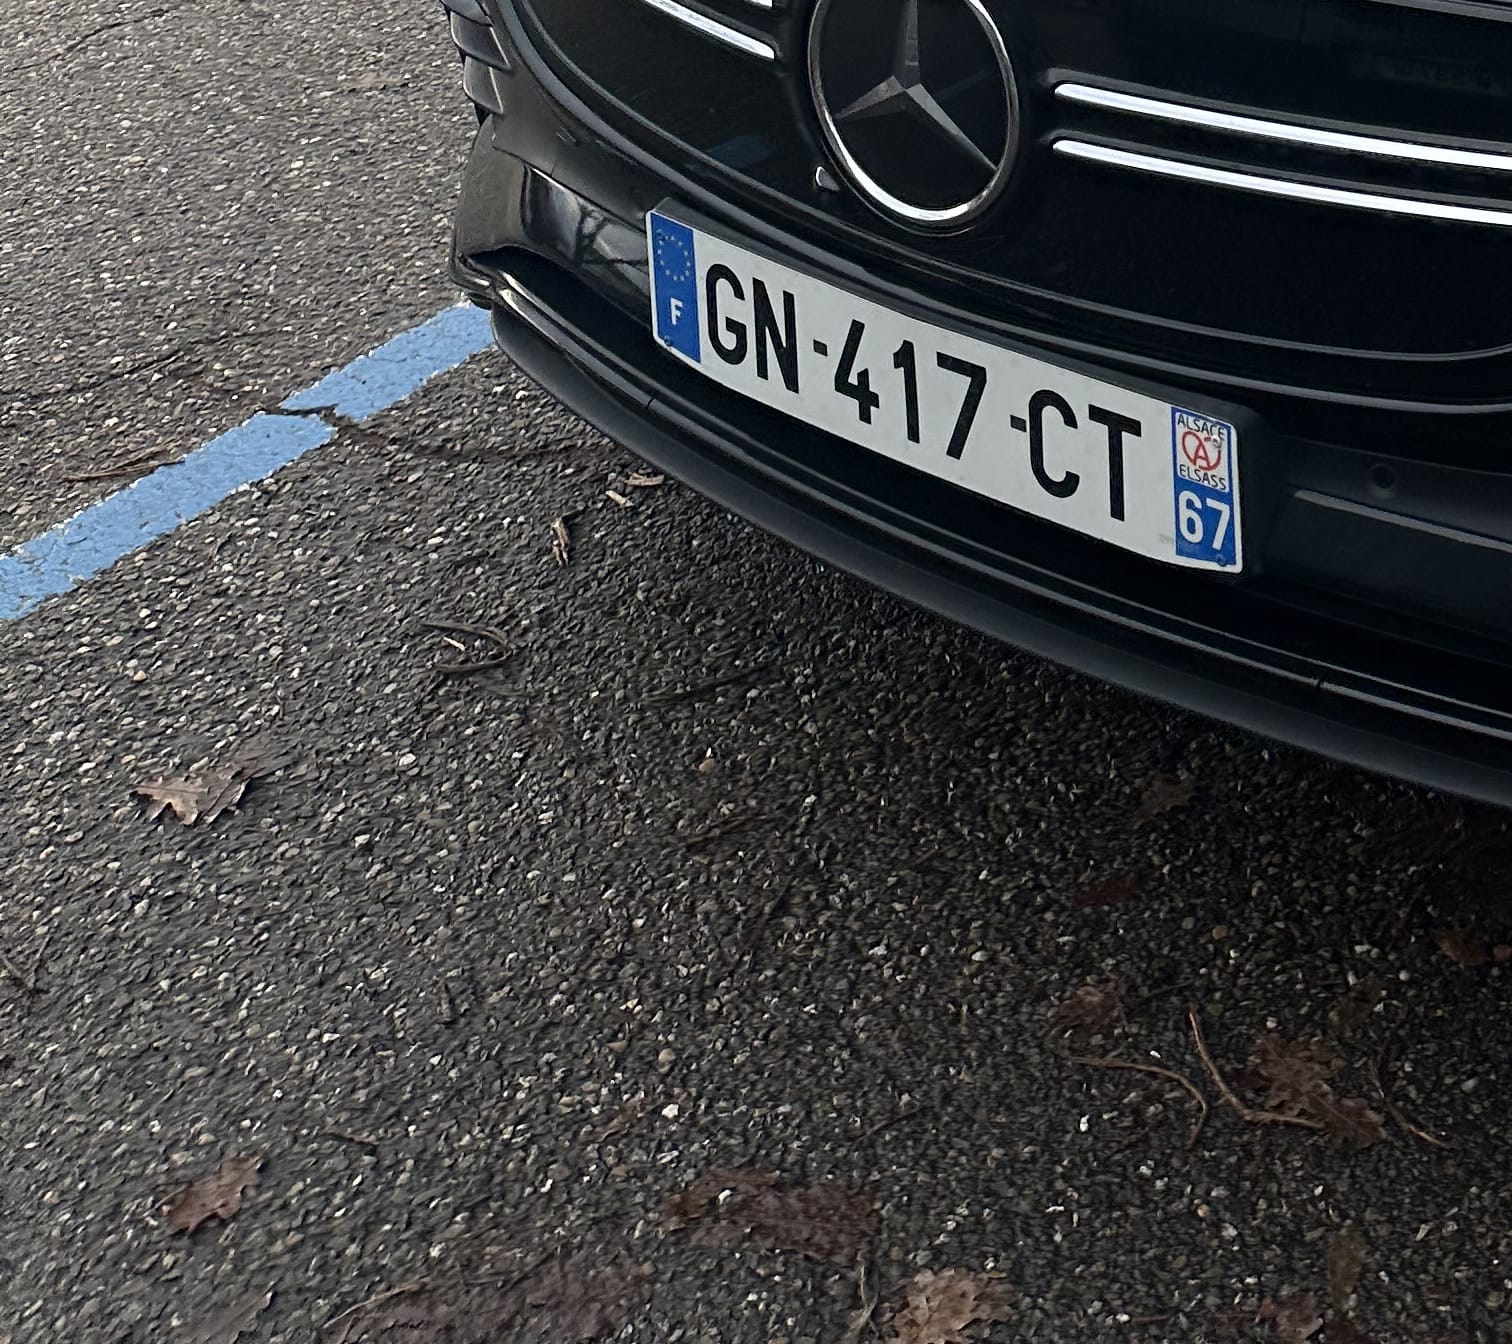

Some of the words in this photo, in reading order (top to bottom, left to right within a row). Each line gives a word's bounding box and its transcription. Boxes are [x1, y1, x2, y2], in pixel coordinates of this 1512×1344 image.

[669, 296, 684, 327] F
[704, 263, 1143, 523] GN-417-CT
[1177, 413, 1226, 442] ALSACE
[1179, 464, 1227, 491] ELSASS
[1178, 490, 1231, 551] 67
